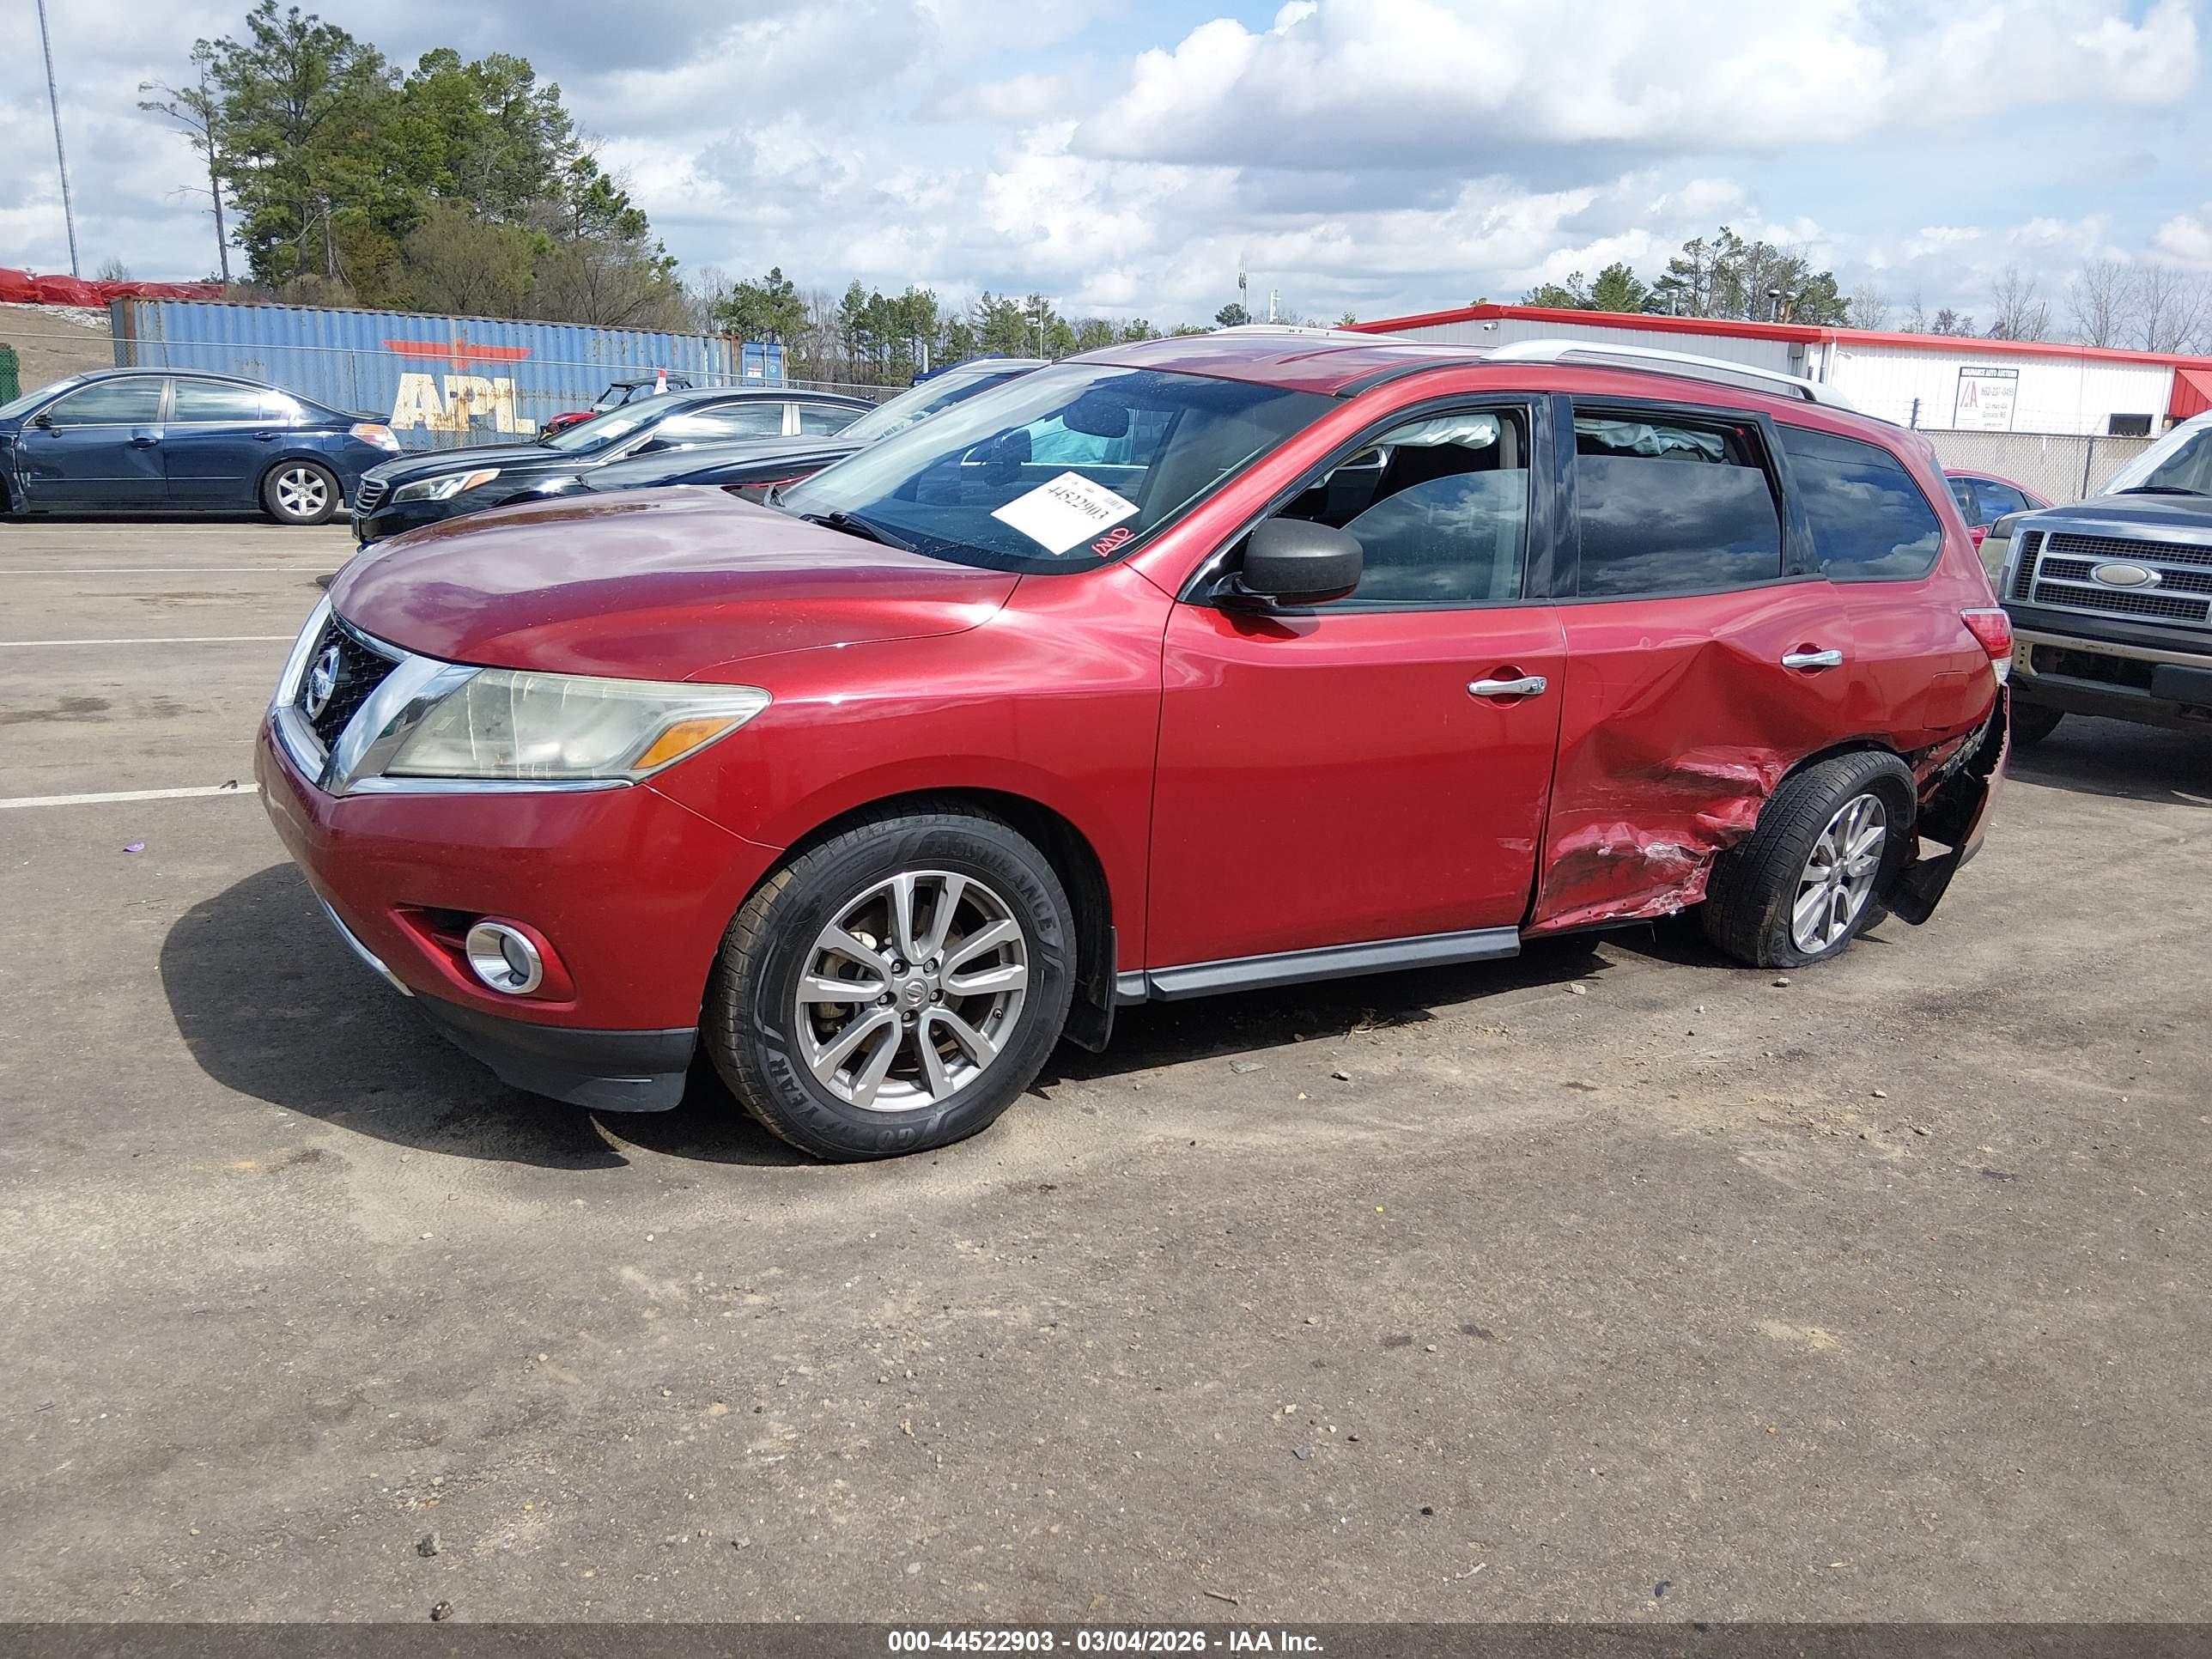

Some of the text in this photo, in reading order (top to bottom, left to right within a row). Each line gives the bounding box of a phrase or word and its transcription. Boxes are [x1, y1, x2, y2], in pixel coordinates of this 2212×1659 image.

[1985, 368, 1997, 377] AUTO
[388, 373, 536, 434] APL
[1047, 486, 1109, 520] 44522903
